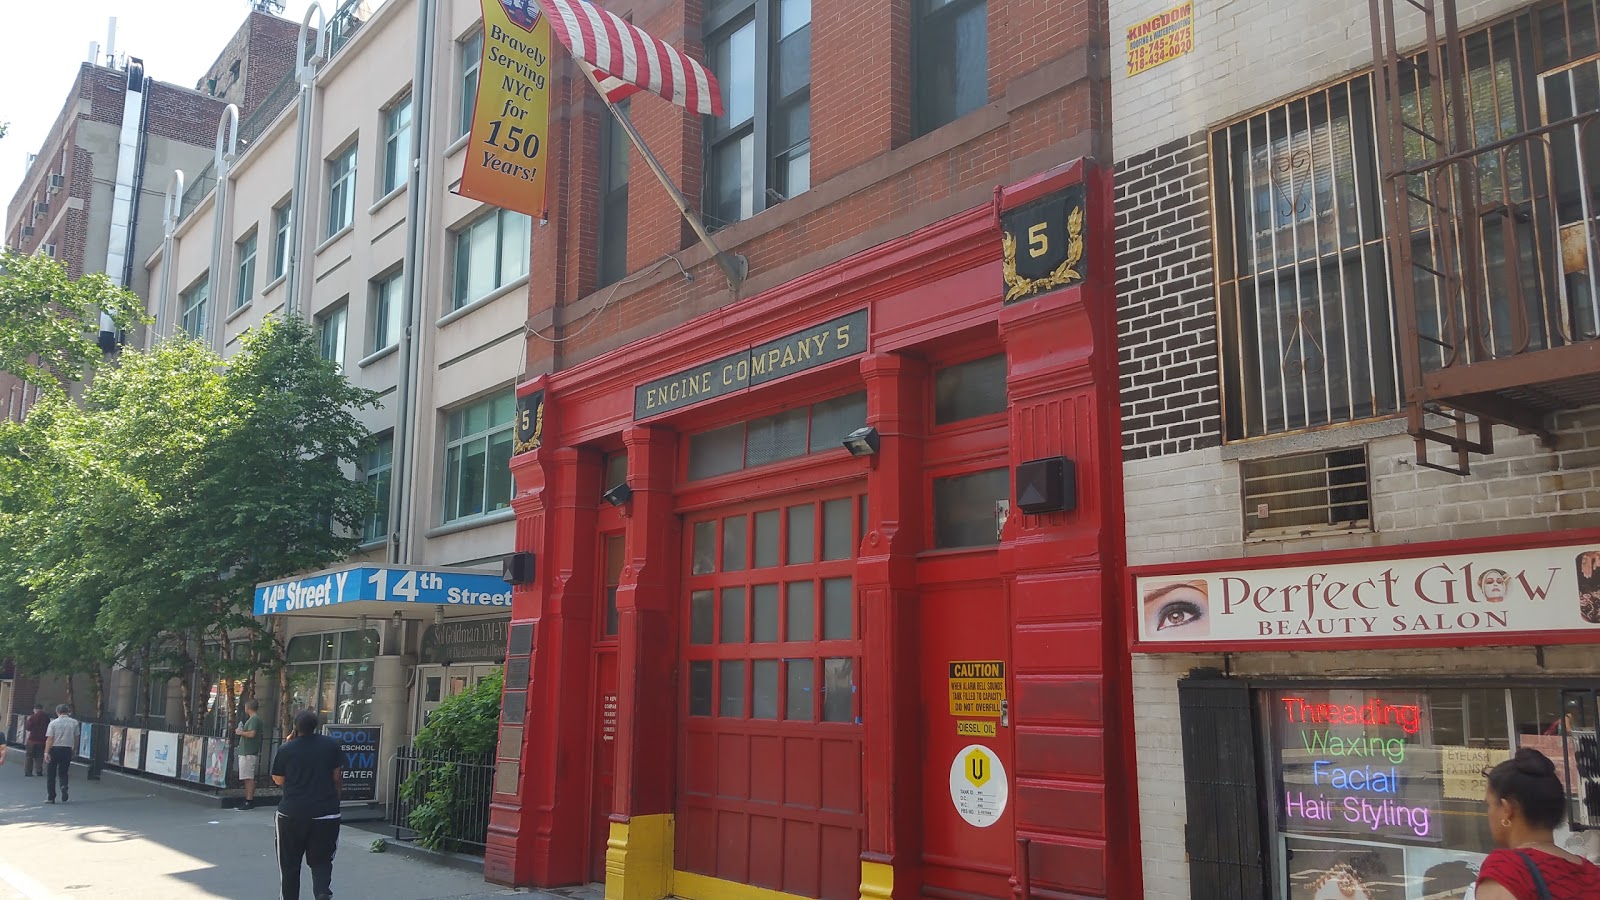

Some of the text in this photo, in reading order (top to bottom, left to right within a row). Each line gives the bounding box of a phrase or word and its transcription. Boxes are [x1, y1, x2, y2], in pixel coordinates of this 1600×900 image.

[1128, 4, 1191, 41] KINGDOM
[490, 23, 547, 67] Bravely
[1129, 26, 1191, 63] 718-745-7475
[1129, 39, 1192, 74] 718-434-0020
[488, 46, 546, 90] Serving
[501, 75, 534, 102] NYC
[500, 99, 528, 121] for
[484, 120, 540, 159] 150
[481, 151, 537, 183] Years!
[1028, 222, 1048, 258] 5
[646, 324, 851, 410] ENGINE COMPANY 5
[522, 409, 530, 431] 5
[262, 571, 349, 614] 14th Street Y
[368, 569, 512, 607] 14th Street
[1219, 567, 1401, 621] Perfect
[445, 623, 479, 645] Goldman
[1257, 610, 1509, 636] BEAUTY SALON
[951, 682, 1003, 691] WHEN ALARM BELL SOUNDS
[954, 663, 999, 677] CAUTION
[952, 692, 1002, 701] TANK FILLED TO CAPACITY
[955, 703, 1001, 712] DO NOT OVERFILL
[1282, 697, 1422, 734] Threading
[342, 752, 375, 769] YM
[1301, 730, 1406, 764] Waxing
[1448, 750, 1490, 763] EYELASH
[341, 770, 374, 779] EATER
[972, 758, 983, 780] U
[1312, 760, 1398, 794] Facial
[1286, 791, 1430, 836] Hair Styling
